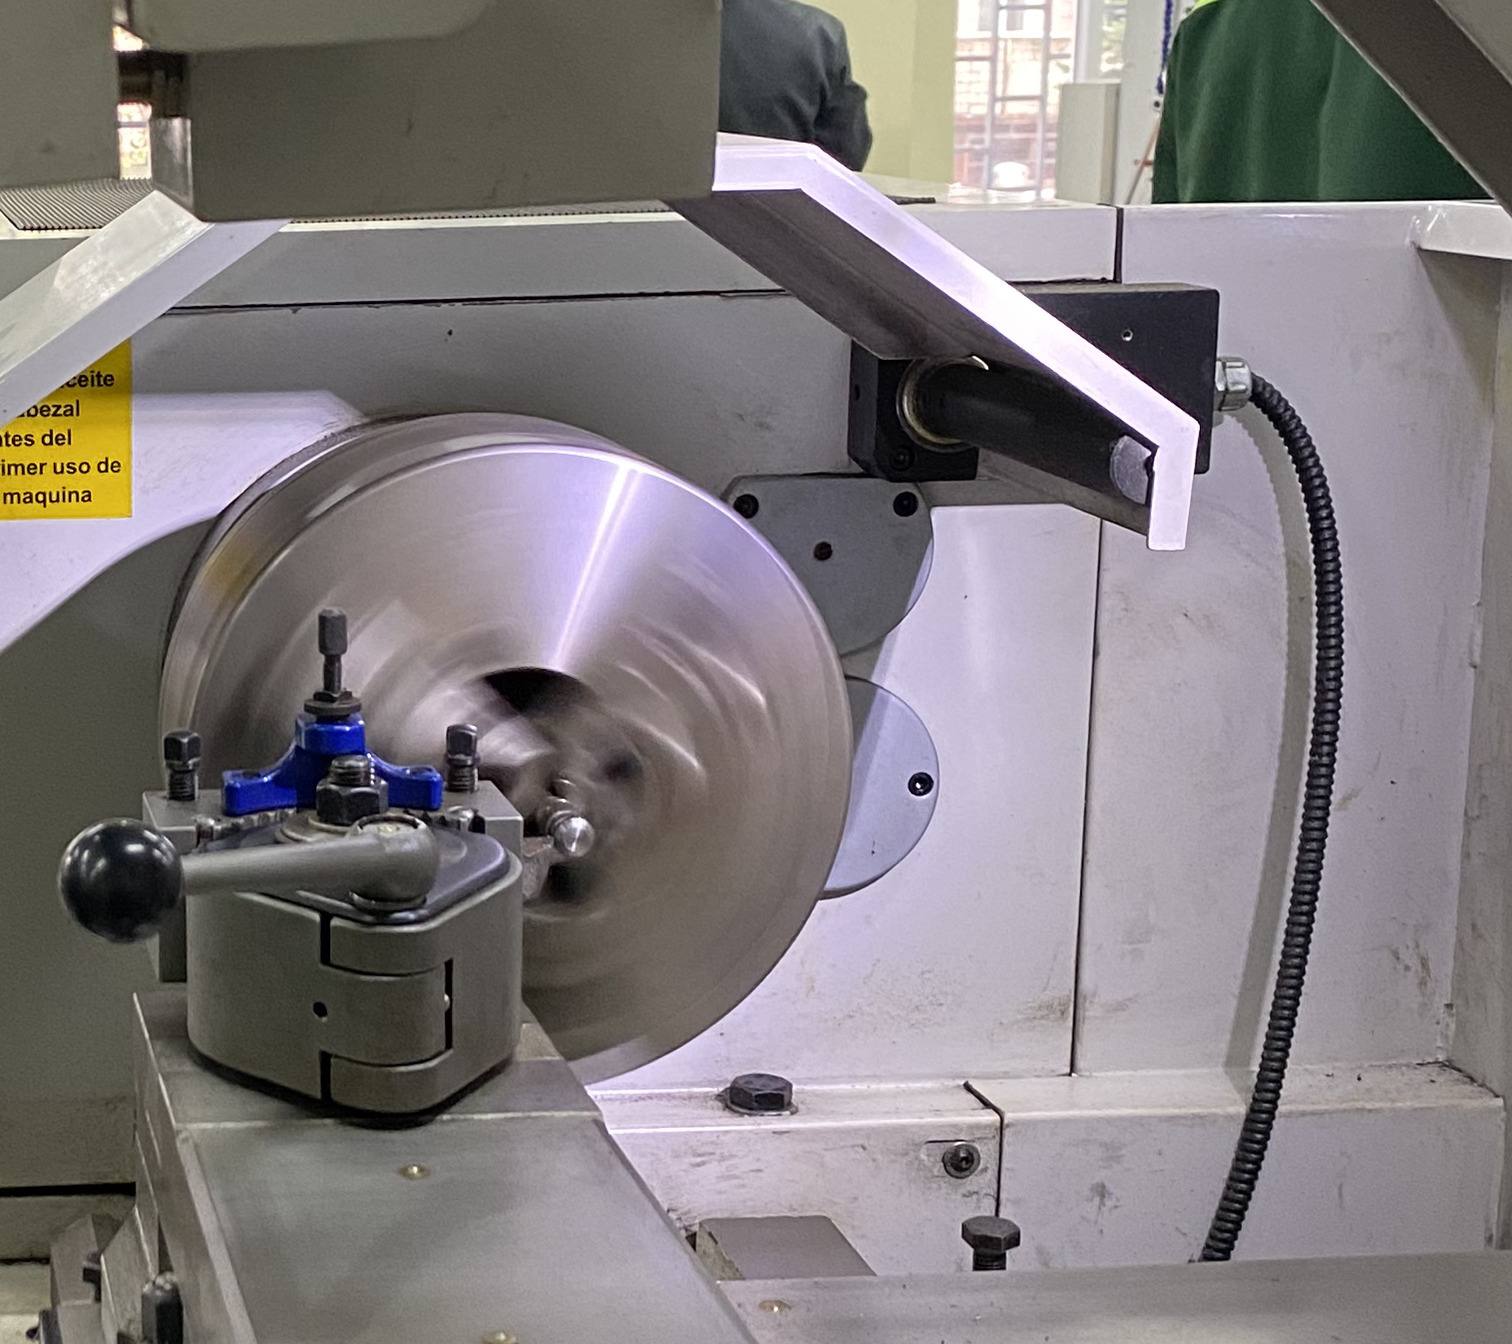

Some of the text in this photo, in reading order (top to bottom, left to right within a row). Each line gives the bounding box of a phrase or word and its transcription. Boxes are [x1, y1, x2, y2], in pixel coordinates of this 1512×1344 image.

[59, 370, 115, 388] ceite
[41, 429, 72, 446] del
[53, 461, 91, 475] uso
[97, 457, 121, 474] de
[3, 486, 92, 508] maquina
